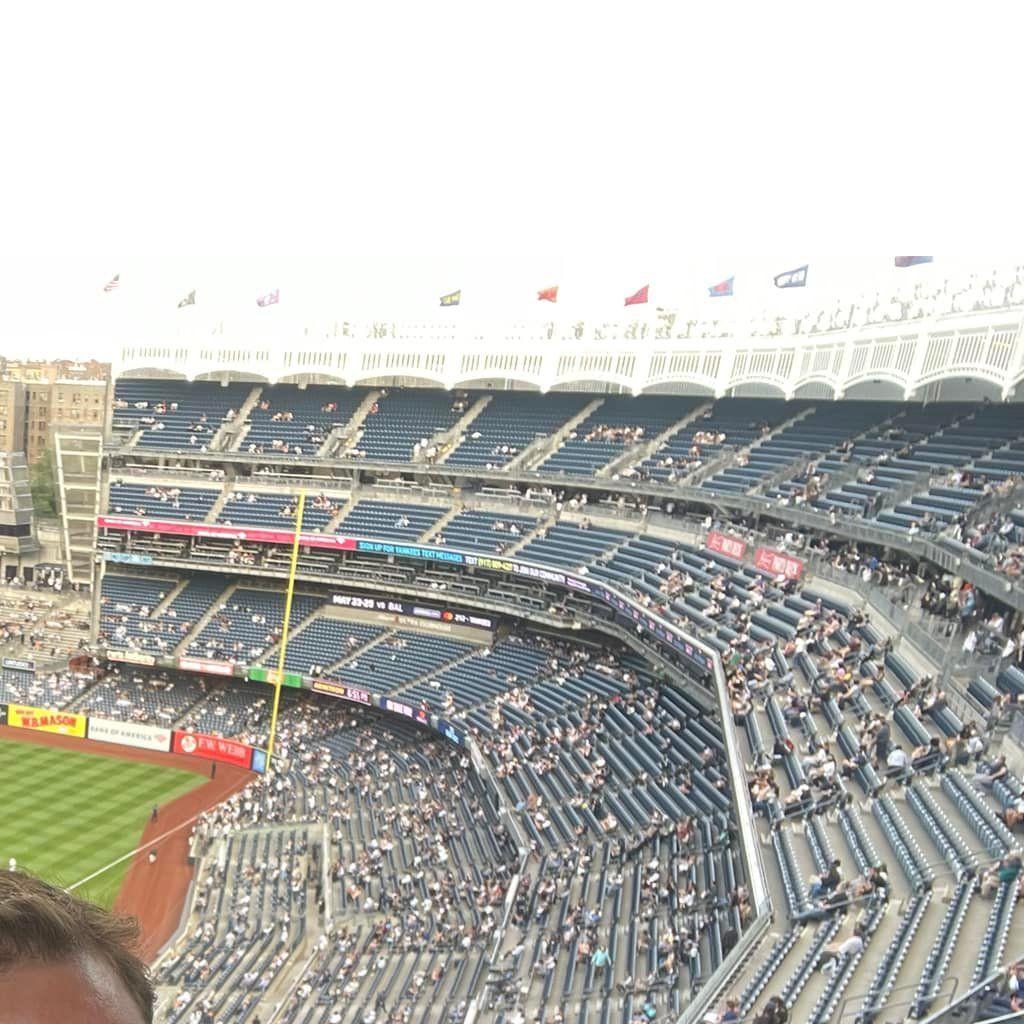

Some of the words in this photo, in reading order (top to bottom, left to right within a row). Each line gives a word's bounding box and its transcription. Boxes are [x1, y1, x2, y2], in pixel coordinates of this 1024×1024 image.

[332, 595, 352, 606] MAY
[387, 603, 404, 613] BAL
[39, 715, 77, 727] MASON
